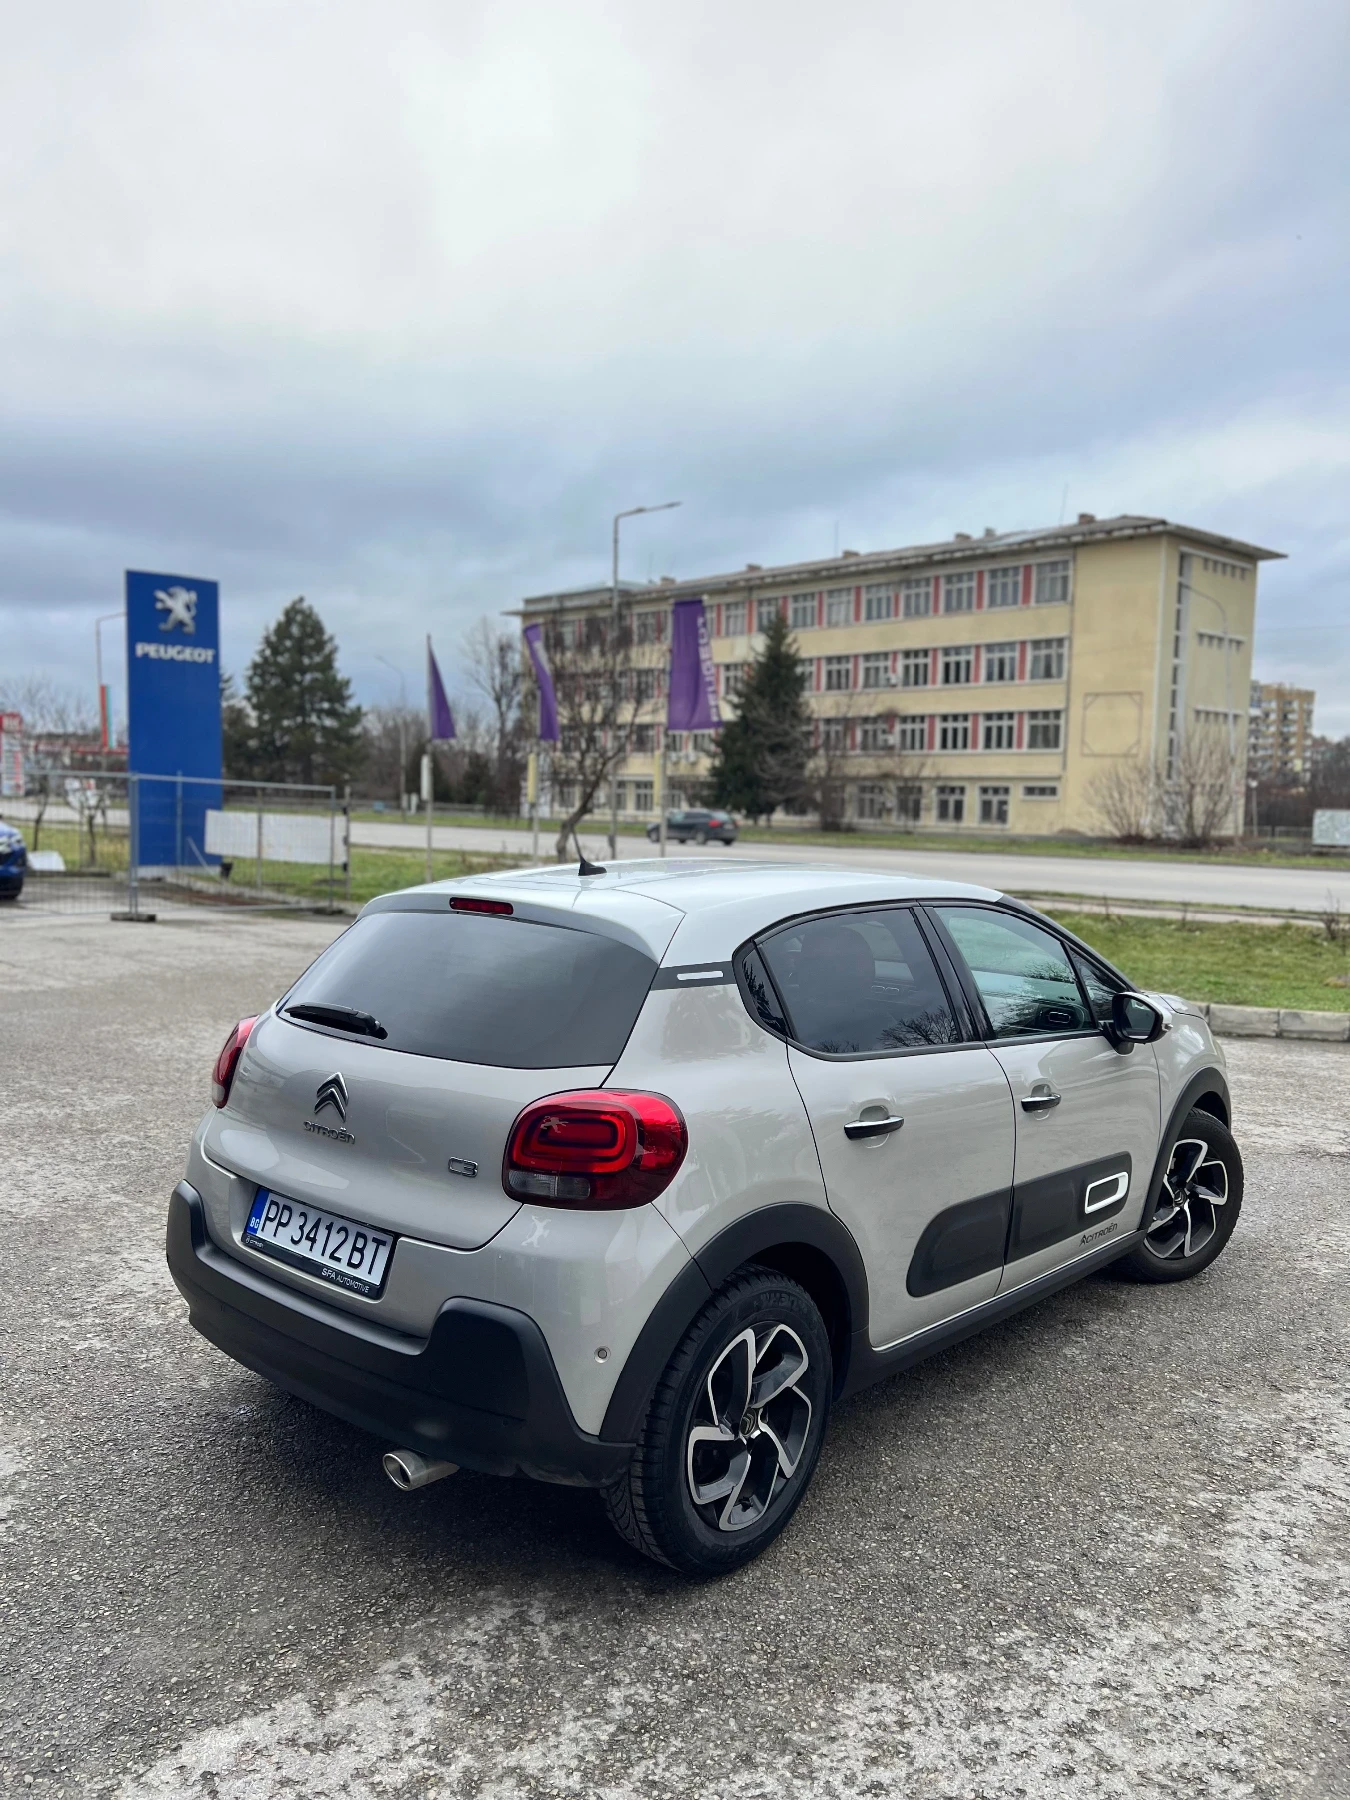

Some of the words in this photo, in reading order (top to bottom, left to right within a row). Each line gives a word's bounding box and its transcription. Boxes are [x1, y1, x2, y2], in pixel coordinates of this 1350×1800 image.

[135, 642, 216, 664] PEUGEOT
[448, 1156, 479, 1178] C3
[250, 1216, 260, 1229] BG
[321, 1268, 336, 1280] SFA
[336, 1276, 370, 1294] AUTOMOTIVE
